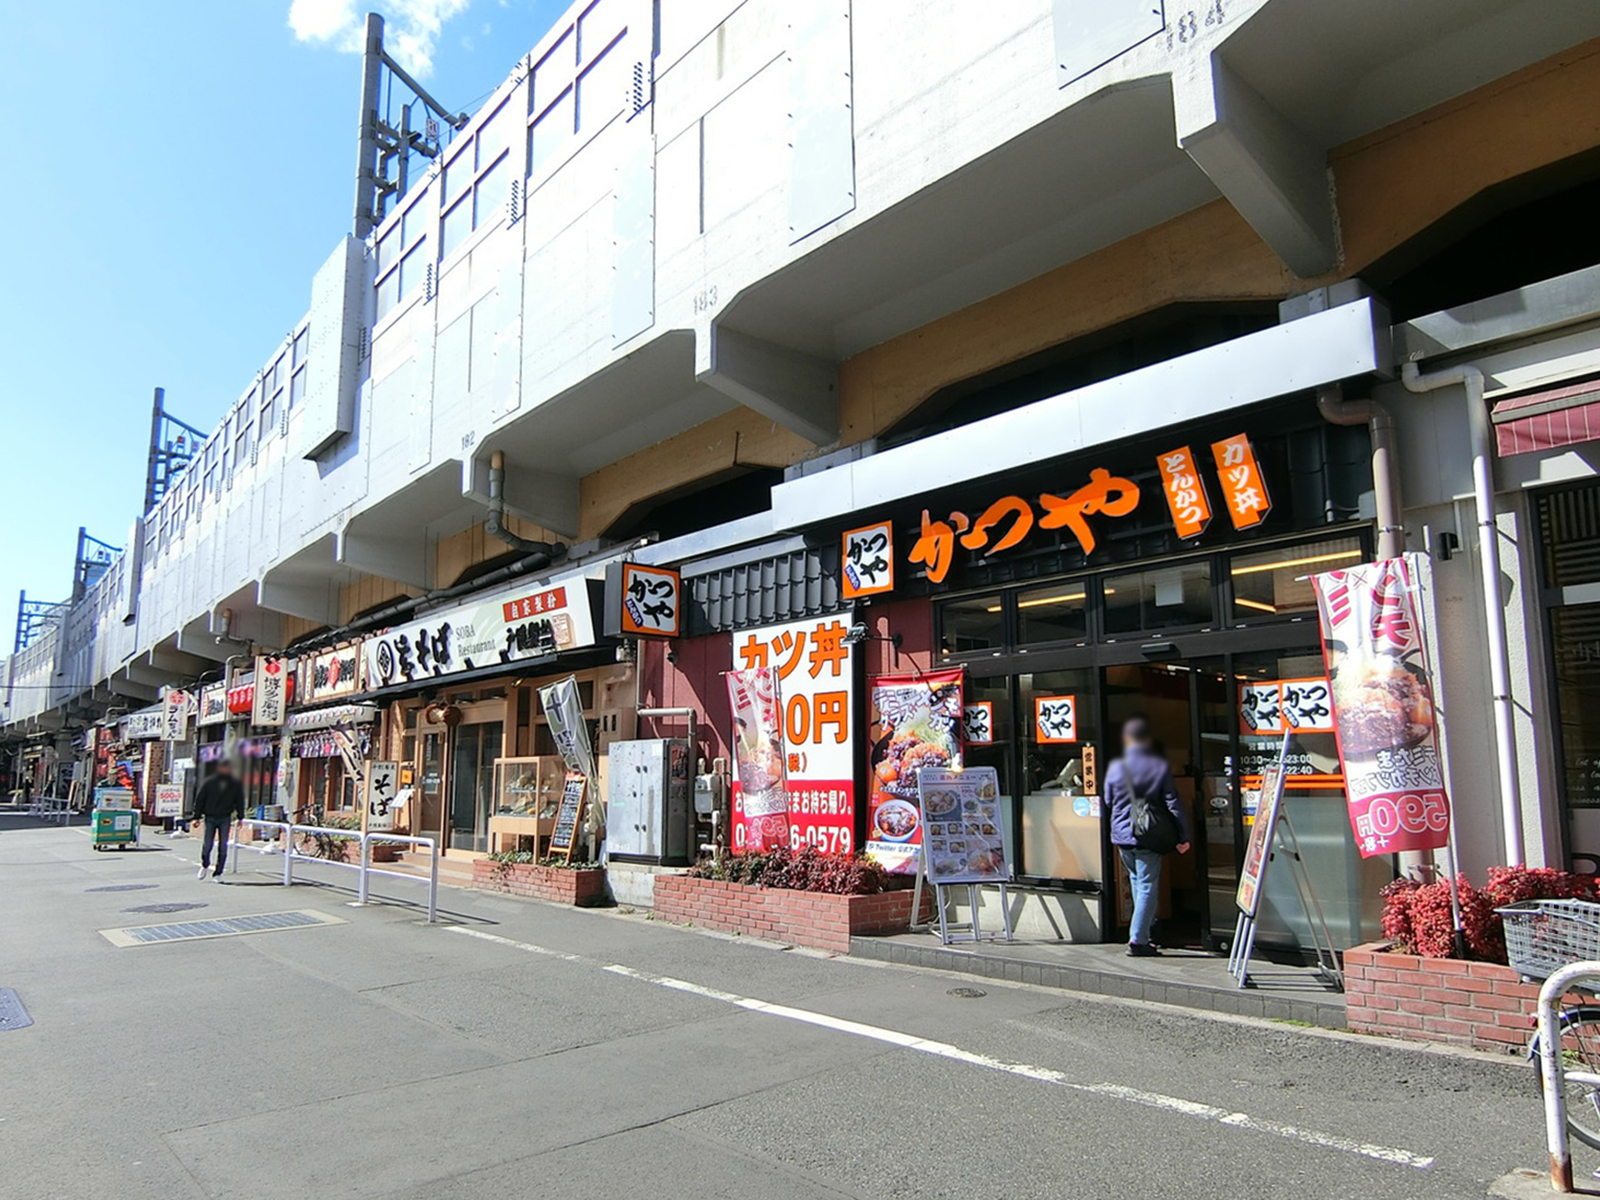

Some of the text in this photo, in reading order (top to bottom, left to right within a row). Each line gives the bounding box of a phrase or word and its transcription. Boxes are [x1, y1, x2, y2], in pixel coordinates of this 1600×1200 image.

[693, 284, 718, 316] 183
[461, 430, 475, 450] 182
[1161, 453, 1203, 526] とんかつ
[1219, 442, 1264, 515] カツ丼
[907, 466, 1140, 584] かつや
[846, 533, 888, 585] かつや
[628, 573, 674, 627] かつや
[455, 623, 475, 641] SOBA
[457, 638, 496, 657] Restaurant
[740, 620, 848, 681] カツ丼
[261, 676, 281, 721] 博多劇場
[776, 690, 848, 745] 0円
[1040, 703, 1072, 736] かつや
[1283, 685, 1329, 725] かつや
[370, 773, 395, 817] そば
